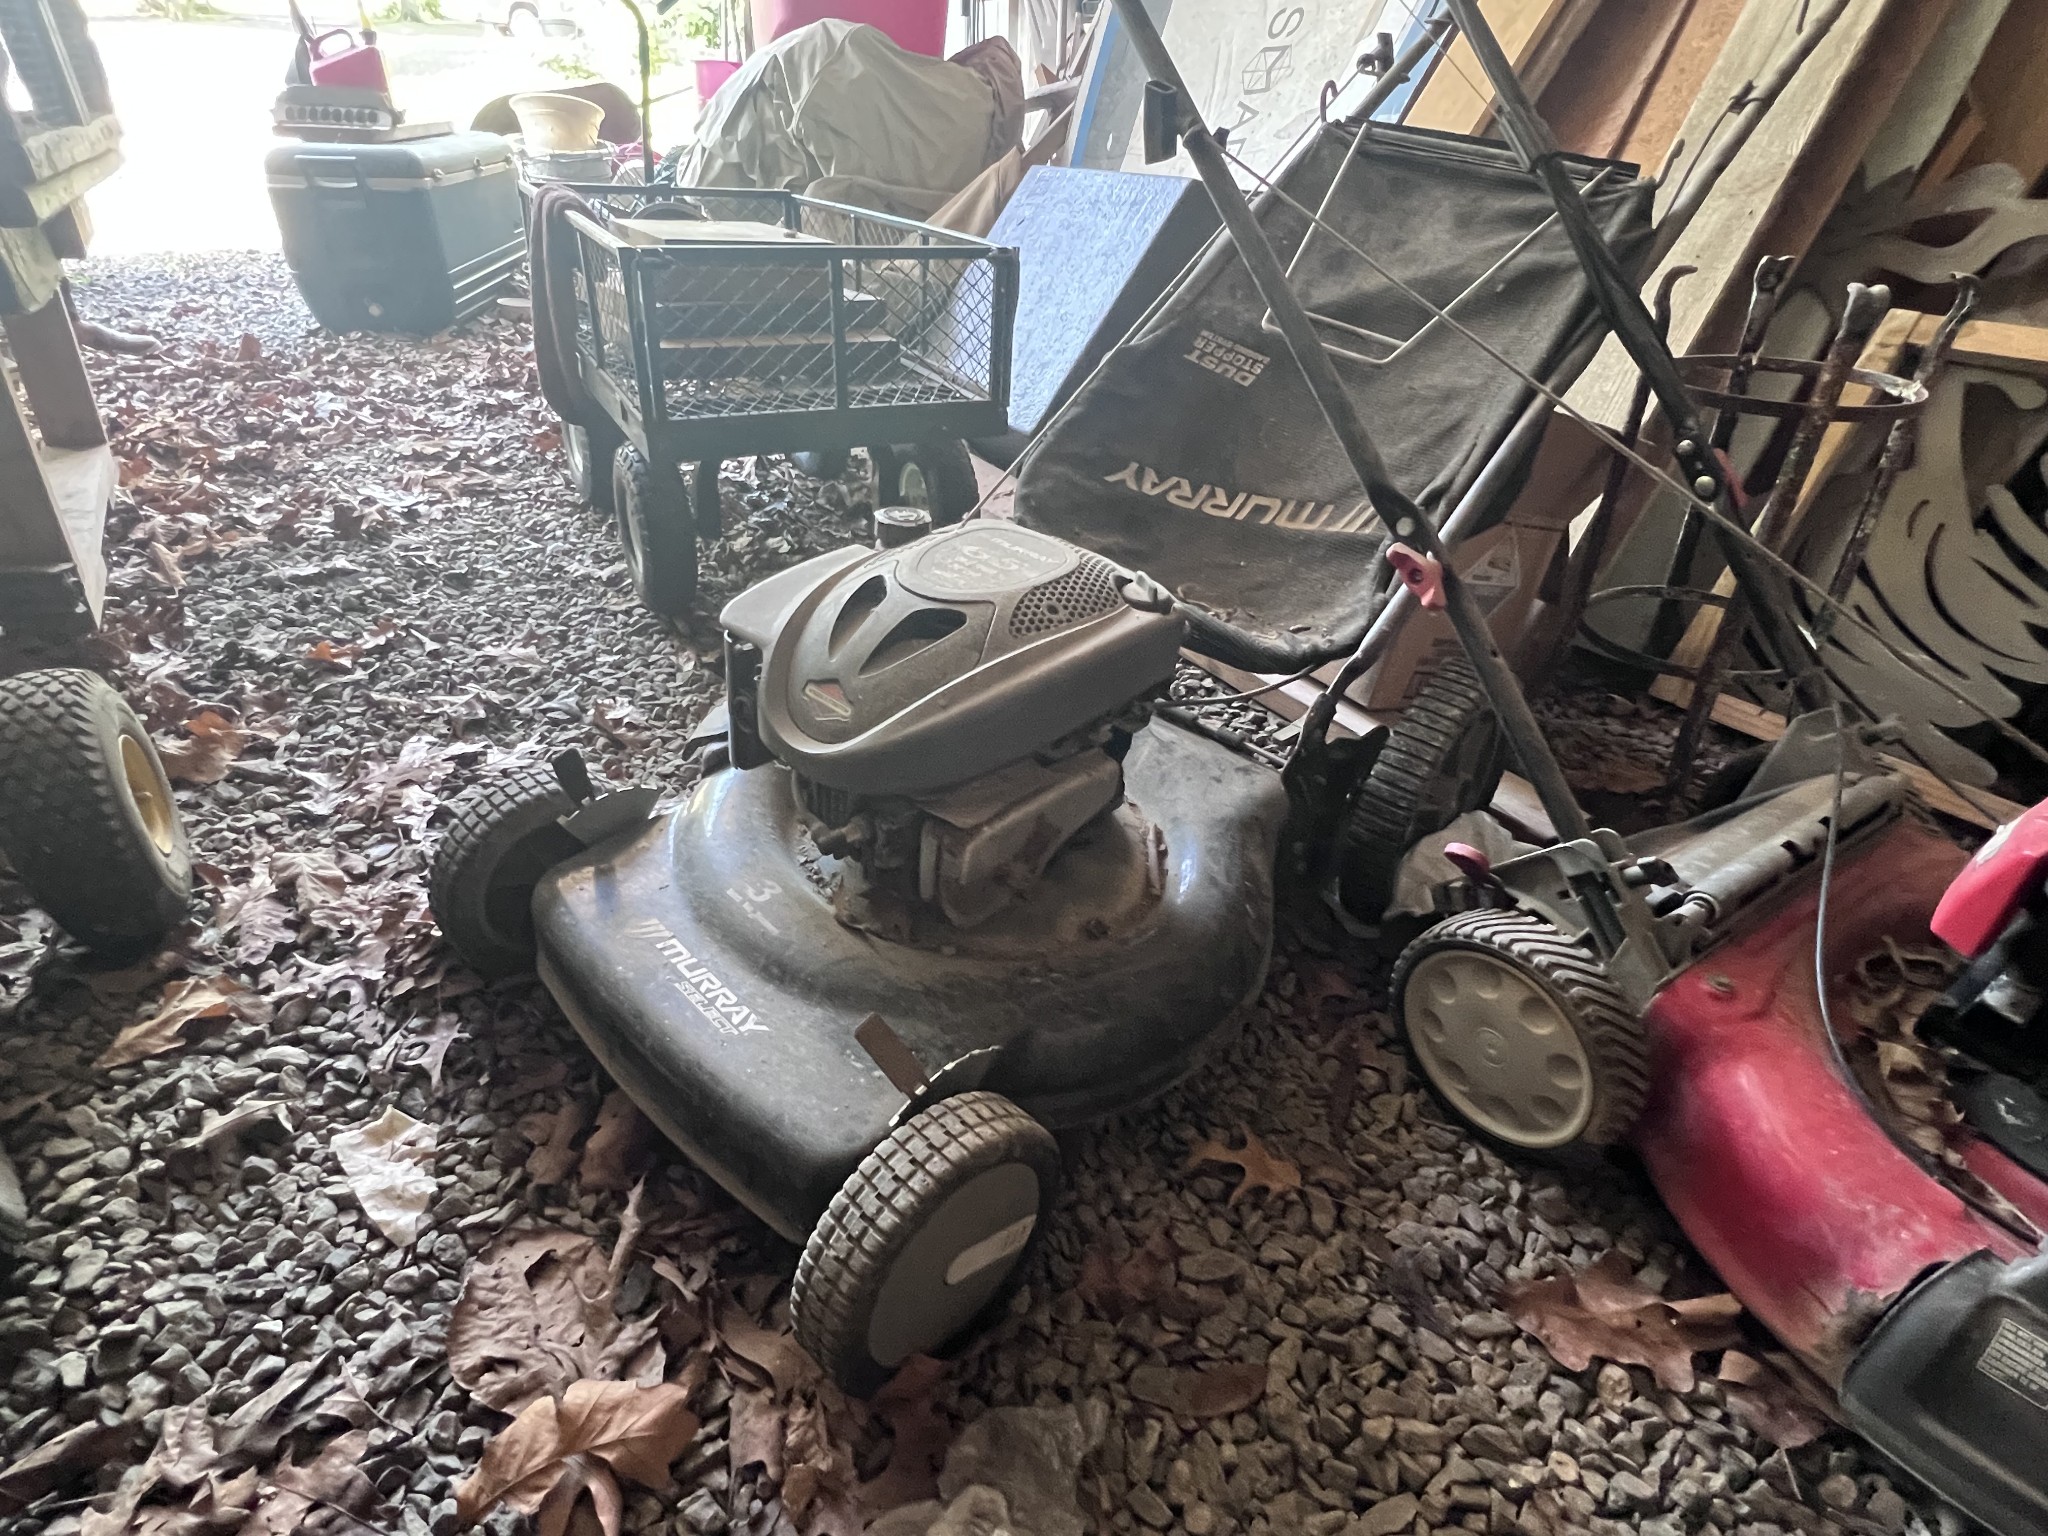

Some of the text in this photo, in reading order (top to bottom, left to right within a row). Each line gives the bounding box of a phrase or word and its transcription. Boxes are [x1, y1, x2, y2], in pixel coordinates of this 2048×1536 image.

[1183, 351, 1256, 387] DUST
[1193, 335, 1265, 375] STOPPER
[1103, 461, 1335, 531] MURRAY
[655, 937, 771, 1033] MURRAY
